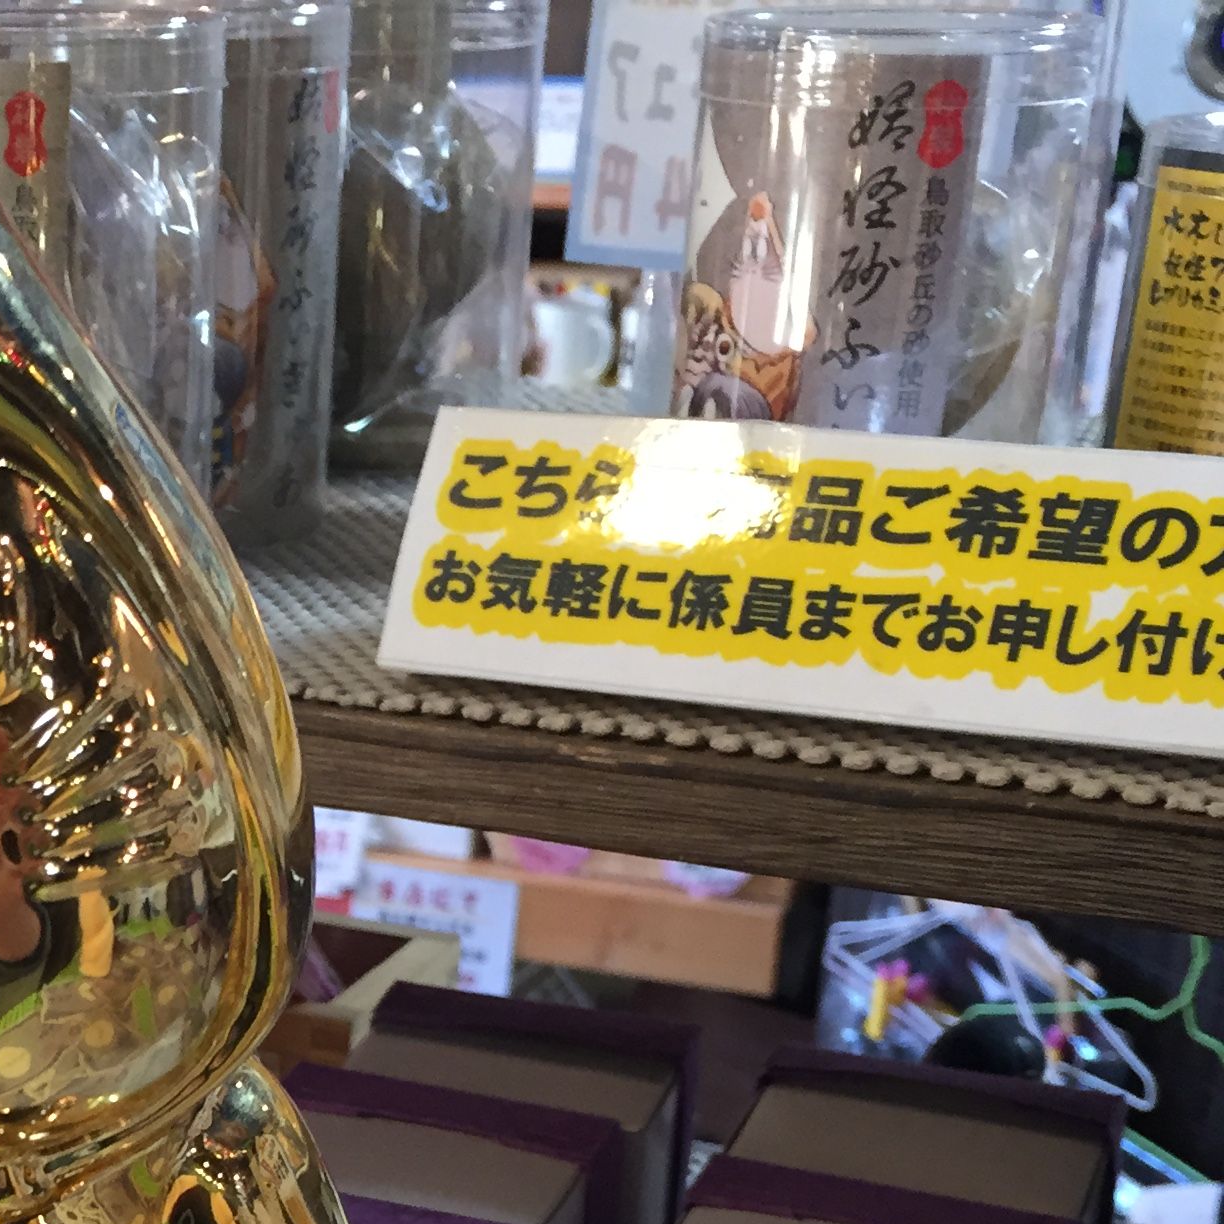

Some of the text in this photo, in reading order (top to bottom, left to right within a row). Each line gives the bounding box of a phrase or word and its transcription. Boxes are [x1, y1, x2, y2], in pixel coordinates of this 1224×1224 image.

[449, 453, 1224, 577] こちら品ご希望の
